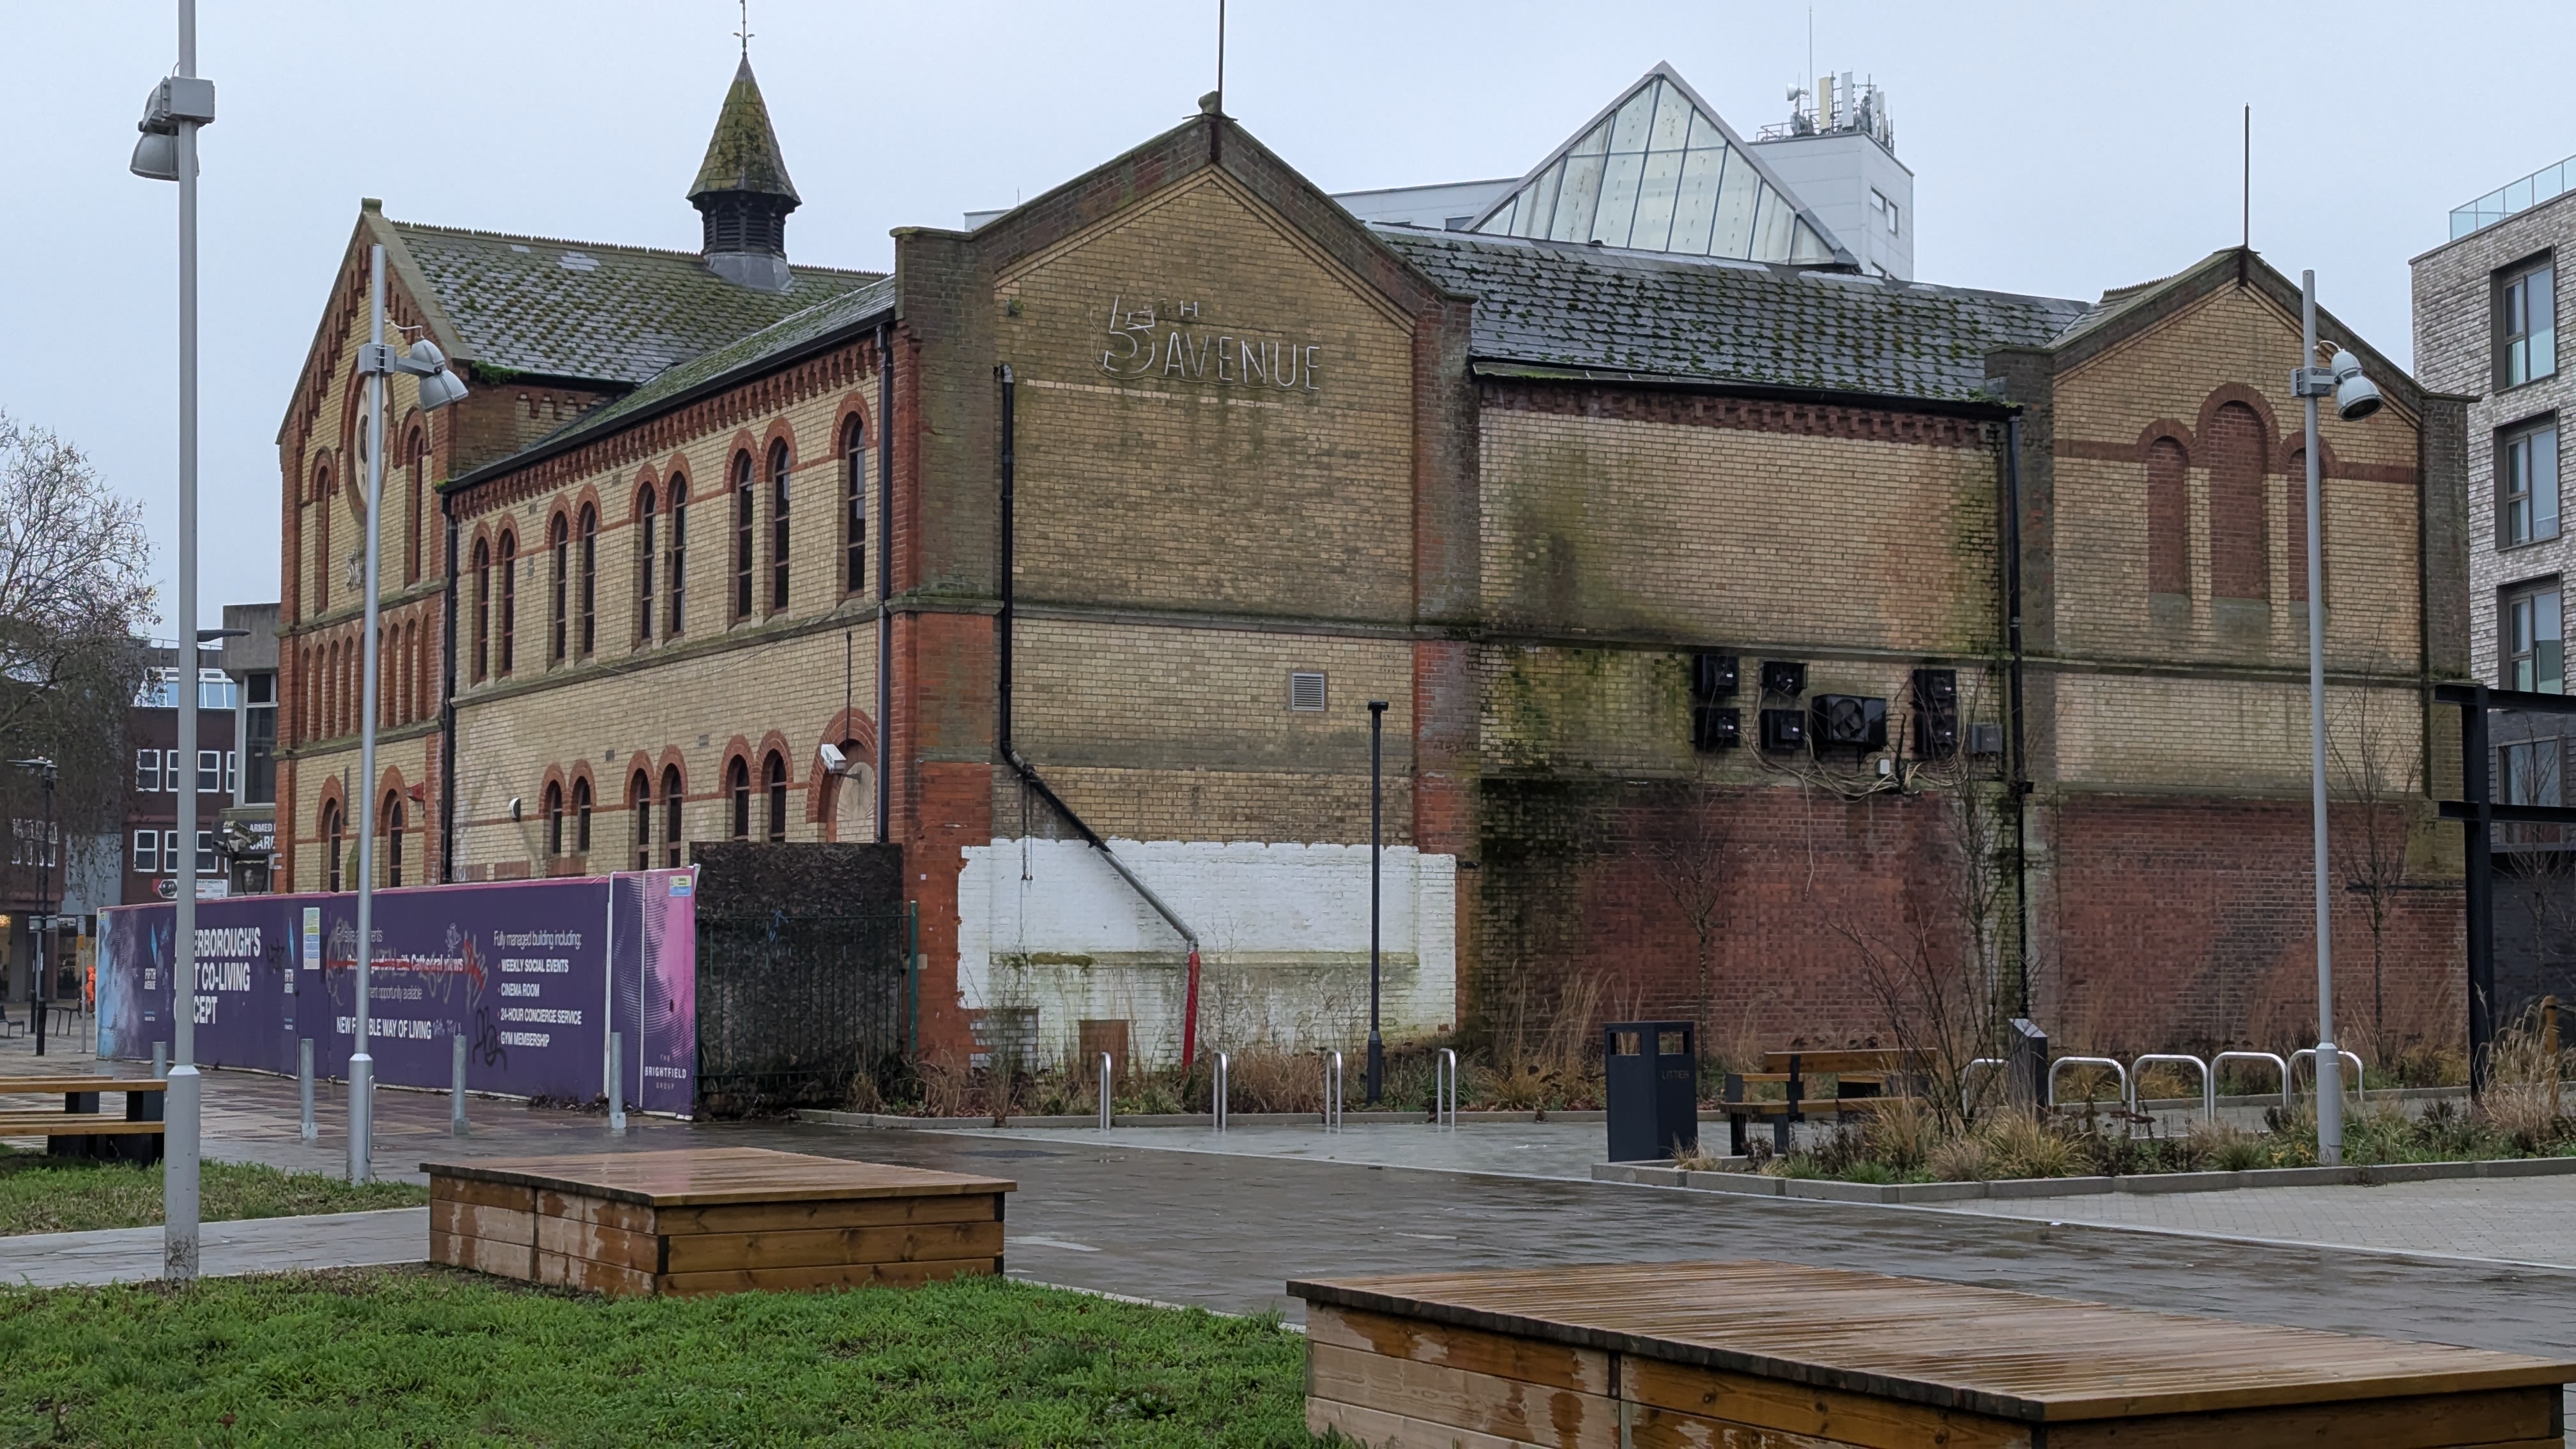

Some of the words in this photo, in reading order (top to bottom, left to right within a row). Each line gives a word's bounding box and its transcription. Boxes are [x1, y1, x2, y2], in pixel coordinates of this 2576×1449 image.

[1165, 332, 1321, 390] AVENUE
[249, 823, 273, 832] ARMED
[174, 927, 261, 957] ERBOROUGH'S
[493, 930, 506, 949] Fully
[507, 930, 532, 951] managed
[532, 930, 554, 950] building
[411, 953, 443, 971] Cathedral
[501, 959, 524, 972] WEEKLY
[525, 959, 545, 972] SOCIAL
[546, 959, 569, 973] EVENTS
[202, 962, 250, 992] CO-LIVING
[501, 983, 522, 997] CINEMA
[523, 983, 540, 997] ROOM
[174, 995, 217, 1024] CEPT
[500, 1008, 524, 1022] 24-HOUR
[525, 1008, 556, 1023] CONCIERGE
[557, 1009, 582, 1025] SERVICE
[336, 1016, 351, 1034] NEW
[352, 1017, 381, 1036] FBLE
[382, 1018, 397, 1038] WAY
[398, 1020, 408, 1038] OF
[409, 1020, 432, 1039] LIVING
[500, 1031, 513, 1045] GYM
[514, 1032, 549, 1047] MEMBERSHIP
[645, 1066, 687, 1079] BRIGHTFIELD
[1662, 1070, 1690, 1080] LITTER
